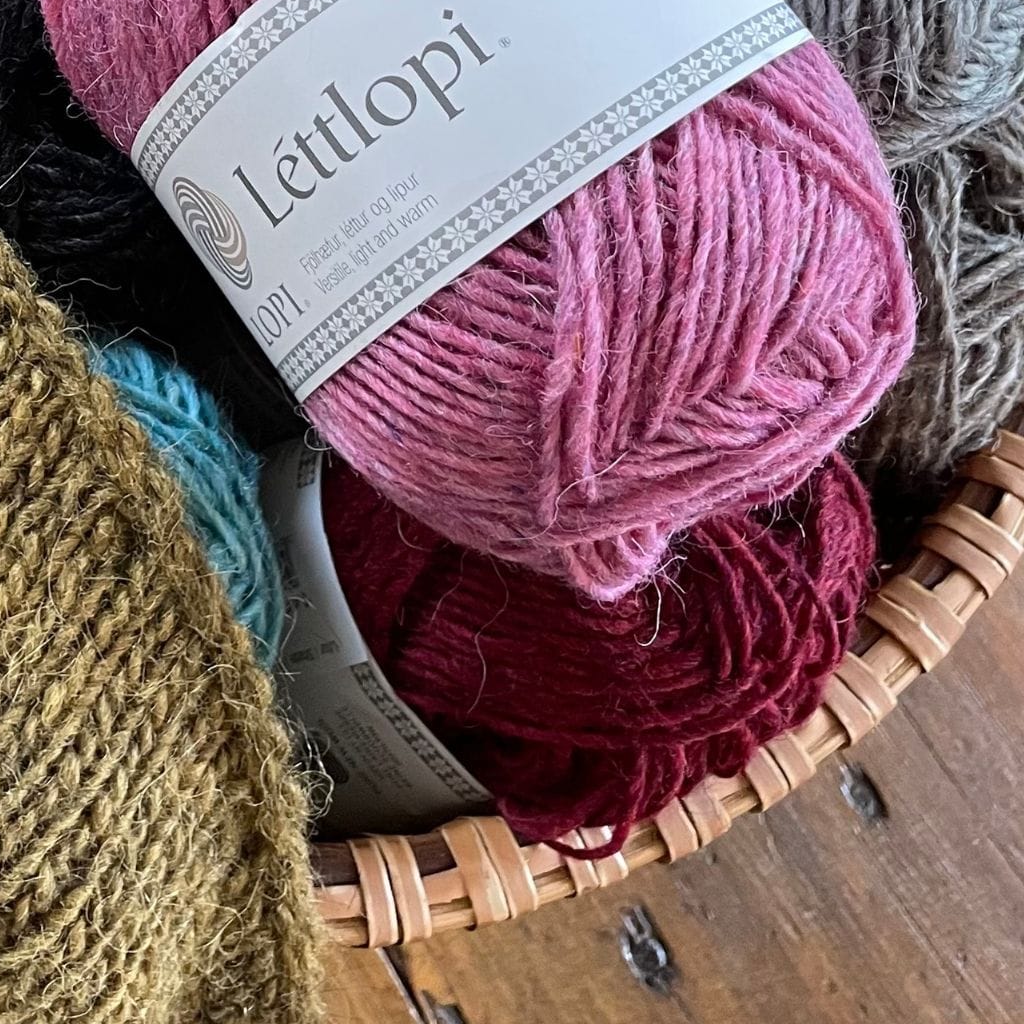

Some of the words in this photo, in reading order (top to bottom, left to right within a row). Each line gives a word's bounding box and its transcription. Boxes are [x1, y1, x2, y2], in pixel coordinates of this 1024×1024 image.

[232, 9, 495, 228] Léttlopi
[339, 210, 370, 239] léttur
[370, 196, 392, 216] og
[385, 172, 420, 202] lipur
[349, 241, 378, 266] light
[373, 219, 399, 248] and
[397, 194, 439, 228] warm
[250, 283, 305, 347] LOPI
